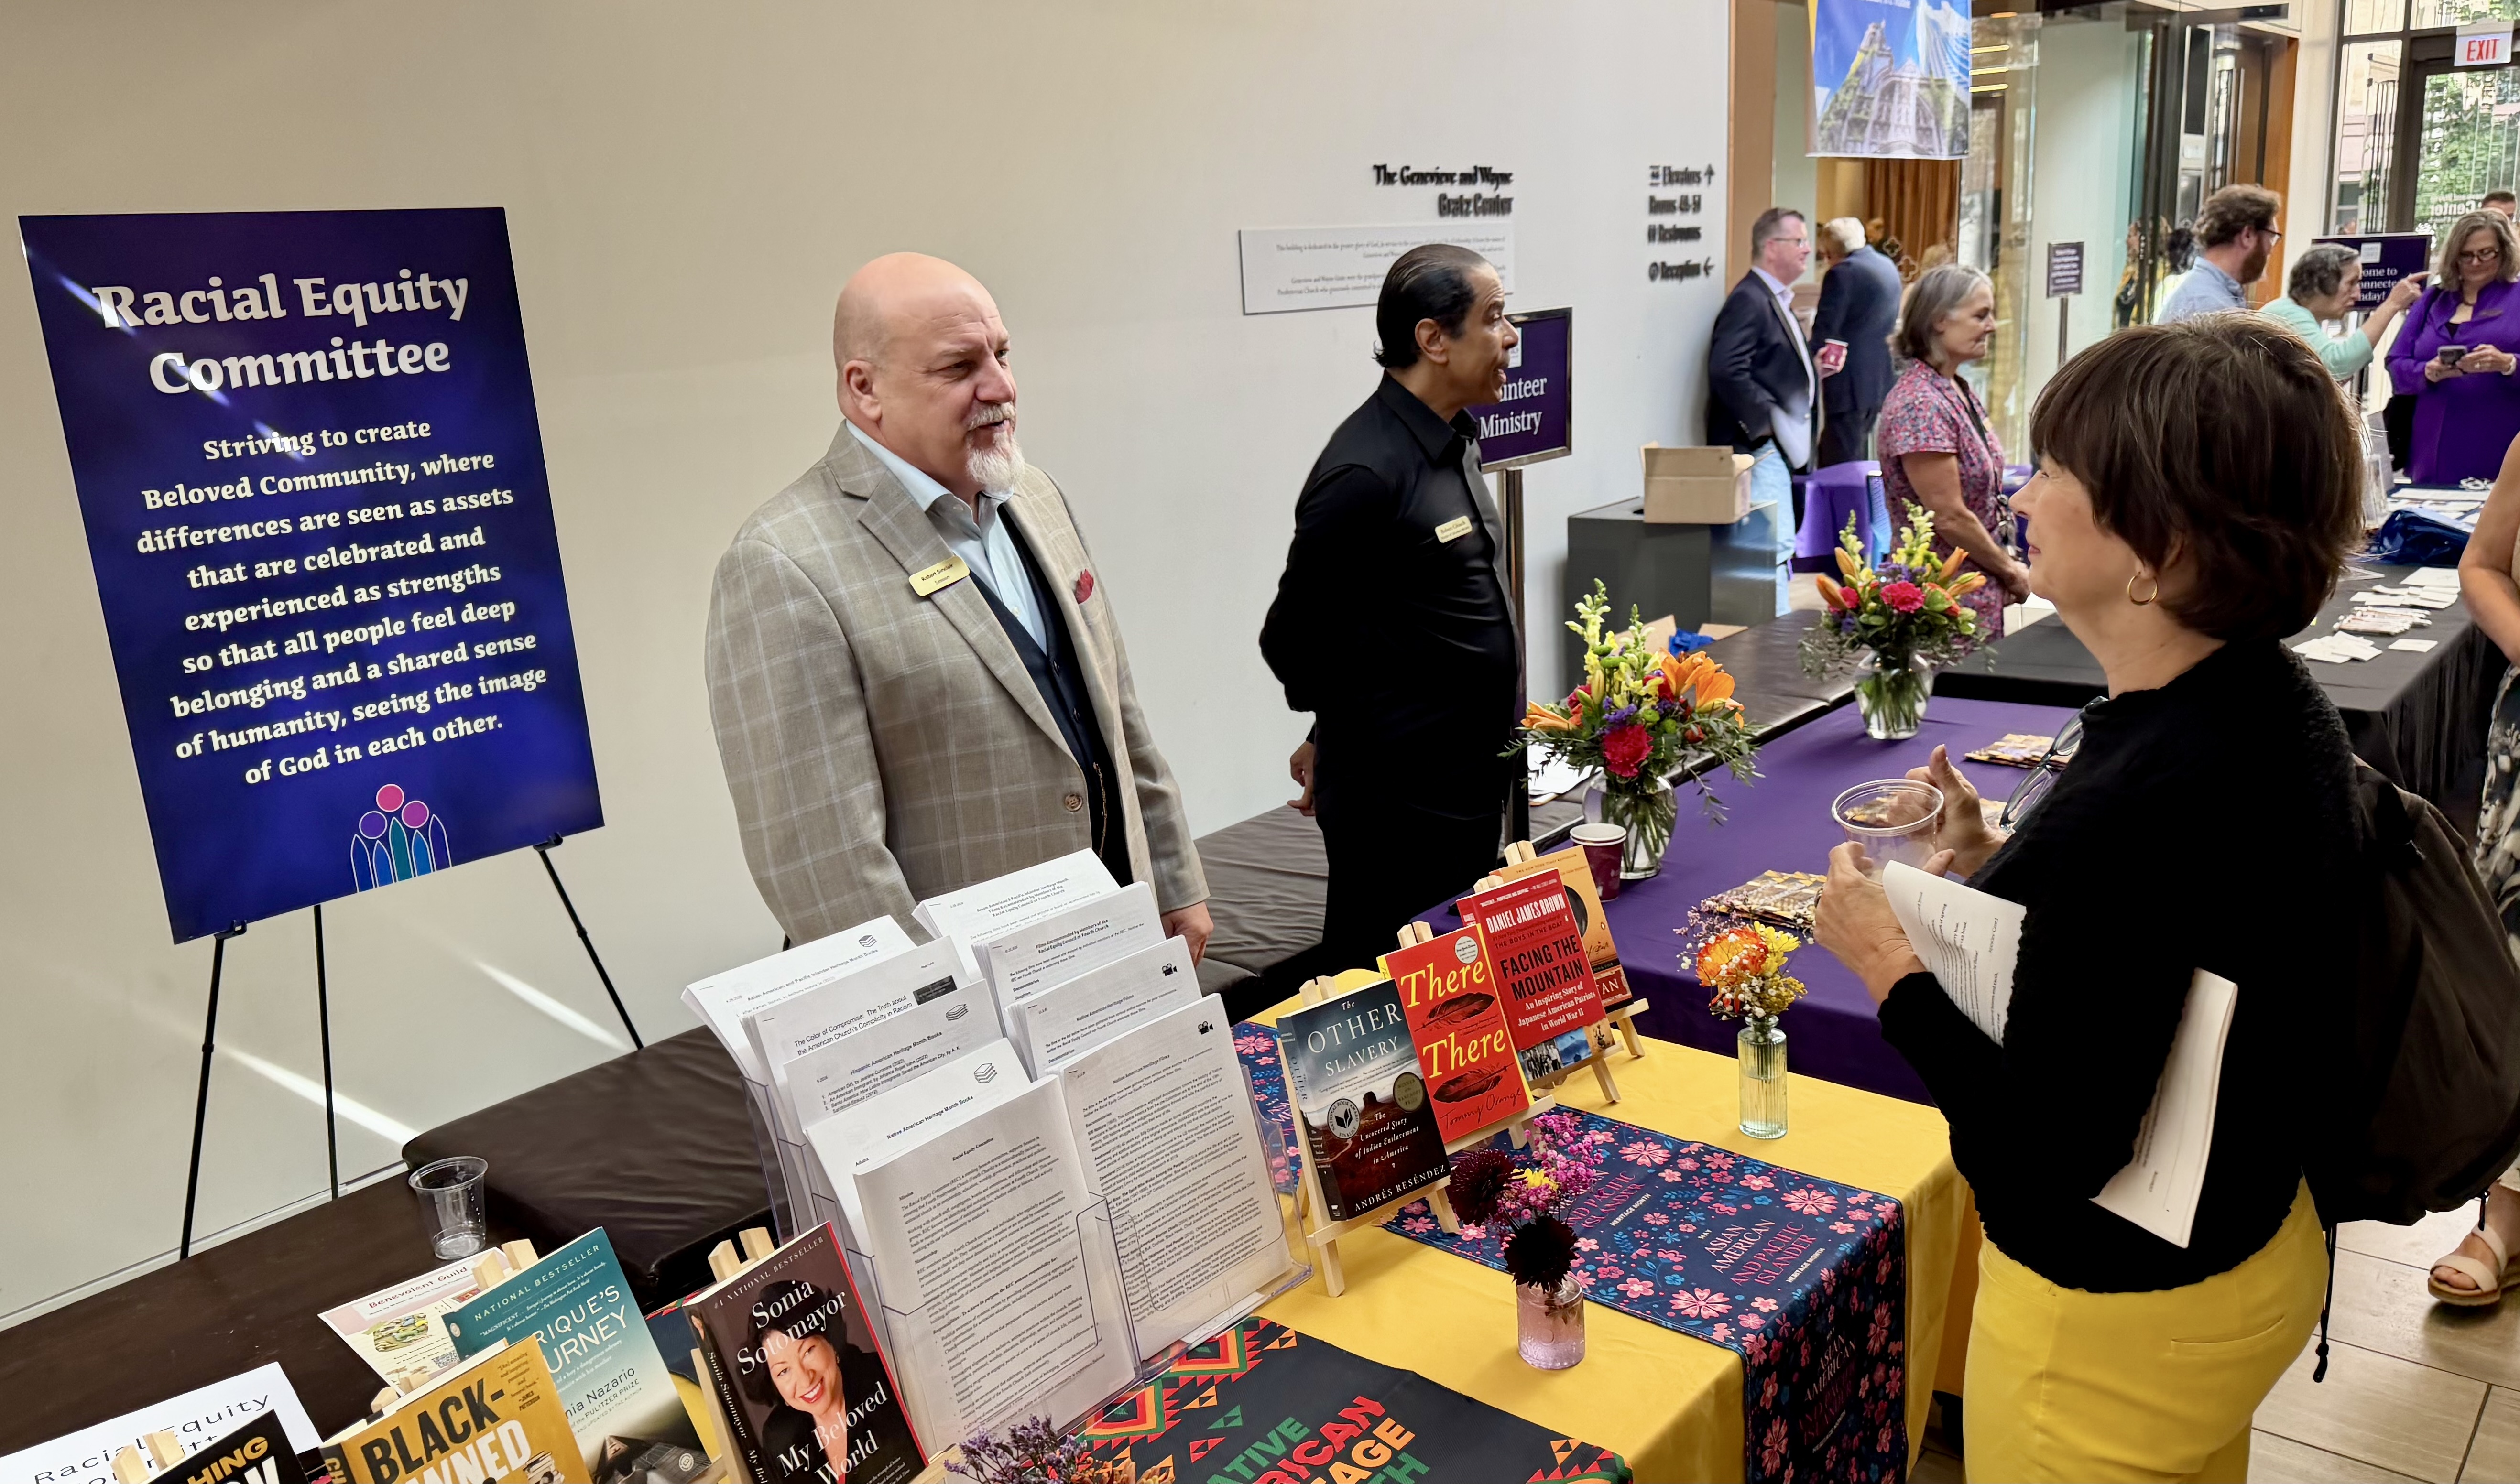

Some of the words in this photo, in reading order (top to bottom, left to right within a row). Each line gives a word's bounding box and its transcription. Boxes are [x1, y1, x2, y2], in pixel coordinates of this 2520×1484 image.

[2467, 39, 2499, 62] EXIT
[92, 274, 285, 328] Racial
[292, 268, 468, 327] Equity
[149, 336, 450, 394] Committee
[1500, 378, 1548, 402] unteer
[203, 431, 316, 460] Striving
[319, 429, 348, 447] to
[354, 421, 431, 444] create
[1479, 412, 1542, 439] Ministry
[141, 476, 254, 509] Beloved
[259, 461, 416, 495] Community,
[420, 453, 494, 476] where
[137, 518, 293, 553] differences
[299, 511, 341, 531] are
[346, 503, 404, 525] seen
[409, 499, 436, 516] as
[442, 488, 513, 512] assets
[186, 563, 248, 588] that
[254, 558, 297, 578] are
[303, 532, 435, 571] celebrated
[439, 525, 486, 551] and
[921, 572, 936, 581] Robert
[185, 585, 349, 632] experienced
[353, 585, 382, 603] as
[386, 563, 501, 597] strengths
[182, 654, 213, 674] so
[218, 639, 278, 667] that
[284, 629, 318, 655] all
[322, 616, 406, 654] people
[410, 606, 456, 632] feel
[460, 601, 515, 623] deep
[169, 675, 307, 717] belonging
[311, 661, 361, 690] and
[366, 663, 383, 679] a
[386, 641, 469, 675] shared
[473, 634, 536, 659] sense
[175, 732, 204, 758] of
[207, 710, 347, 751] humanity,
[351, 690, 431, 721] seeing
[433, 682, 473, 704] the
[477, 669, 546, 695] image
[245, 758, 272, 784] of
[278, 747, 330, 776] God
[333, 744, 362, 764] in
[367, 726, 427, 756] each
[432, 715, 503, 742] other.
[1485, 910, 1517, 933] DANIEL
[1516, 901, 1541, 924] JAMES
[1538, 892, 1566, 915] BROWN
[1494, 940, 1508, 950] THE
[1508, 934, 1526, 944] BOYS
[1534, 926, 1547, 935] THE
[1548, 921, 1562, 931] BOAT
[1499, 944, 1554, 979] FACING
[1551, 934, 1580, 959] THE
[1510, 957, 1584, 1002] MOUNTAIN
[1342, 1001, 1355, 1010] The
[1400, 961, 1485, 1008] There
[1525, 1002, 1535, 1011] An
[1534, 991, 1563, 1007] Inspiring
[1561, 986, 1577, 996] Story
[793, 1039, 806, 1047] The
[805, 1032, 821, 1042] Color
[821, 1027, 828, 1035] of
[828, 1014, 864, 1032] Compromise:
[865, 1008, 877, 1016] The
[876, 1002, 891, 1011] Truth
[891, 994, 907, 1006] about
[796, 1048, 807, 1056] the
[807, 1037, 834, 1052] American
[833, 1026, 858, 1040] Church's
[858, 1013, 886, 1029] Complicity
[892, 1002, 913, 1014] Racism
[1308, 1003, 1402, 1054] OTHER
[1517, 1010, 1547, 1027] Japanese
[1547, 999, 1575, 1016] American
[1573, 991, 1596, 1005] Patriots
[1540, 1023, 1549, 1031] in
[1547, 1015, 1567, 1028] World
[1565, 1011, 1578, 1021] War
[1577, 1008, 1584, 1017] II
[1325, 1036, 1398, 1076] SLAVERY
[1422, 1029, 1506, 1080] There
[886, 1129, 902, 1140] Native
[902, 1118, 925, 1132] American
[924, 1109, 944, 1121] Heritage
[943, 1102, 959, 1112] Month
[958, 1095, 973, 1105] Books
[1360, 1123, 1390, 1141] Uncovered
[1391, 1118, 1407, 1130] Story
[1375, 1112, 1385, 1121] The
[1440, 1105, 1483, 1131] Tommy
[1486, 1088, 1522, 1112] Orange
[1355, 1149, 1362, 1158] of
[1363, 1142, 1382, 1157] Indian
[1373, 1155, 1379, 1164] in
[1381, 1146, 1409, 1161] America
[1355, 1188, 1393, 1211] ANDRÉS
[1396, 1165, 1446, 1192] RESÉNDEZ
[1698, 1229, 1712, 1240] MAY
[1705, 1224, 1746, 1256] ASIAN
[1711, 1219, 1776, 1274] AMERICAN
[1731, 1261, 1762, 1287] AND
[1754, 1222, 1804, 1262] PACIFIC
[475, 1286, 531, 1321] NATIONAL
[534, 1245, 600, 1287] BESTSELLER
[727, 1271, 771, 1300] NATIONAL
[773, 1236, 824, 1273] BESTSELLER
[1754, 1235, 1817, 1286] ISLANDER
[369, 1281, 434, 1308] Benevolent
[438, 1267, 467, 1281] Guild
[752, 1279, 815, 1329] Sonia
[536, 1285, 620, 1344] RIQUE'S
[737, 1291, 846, 1376] Sotomayor
[544, 1305, 626, 1373] URNEY
[585, 1393, 618, 1418] PULITZER
[619, 1379, 640, 1395] PRIZE
[586, 1367, 635, 1404] Nazario
[361, 1378, 505, 1484] BLACK-
[708, 1352, 723, 1386] Sonia
[721, 1384, 747, 1439] Sotomayor
[748, 1450, 758, 1471] My
[777, 1443, 813, 1478] My
[811, 1381, 888, 1452] Beloved
[814, 1430, 880, 1484] World
